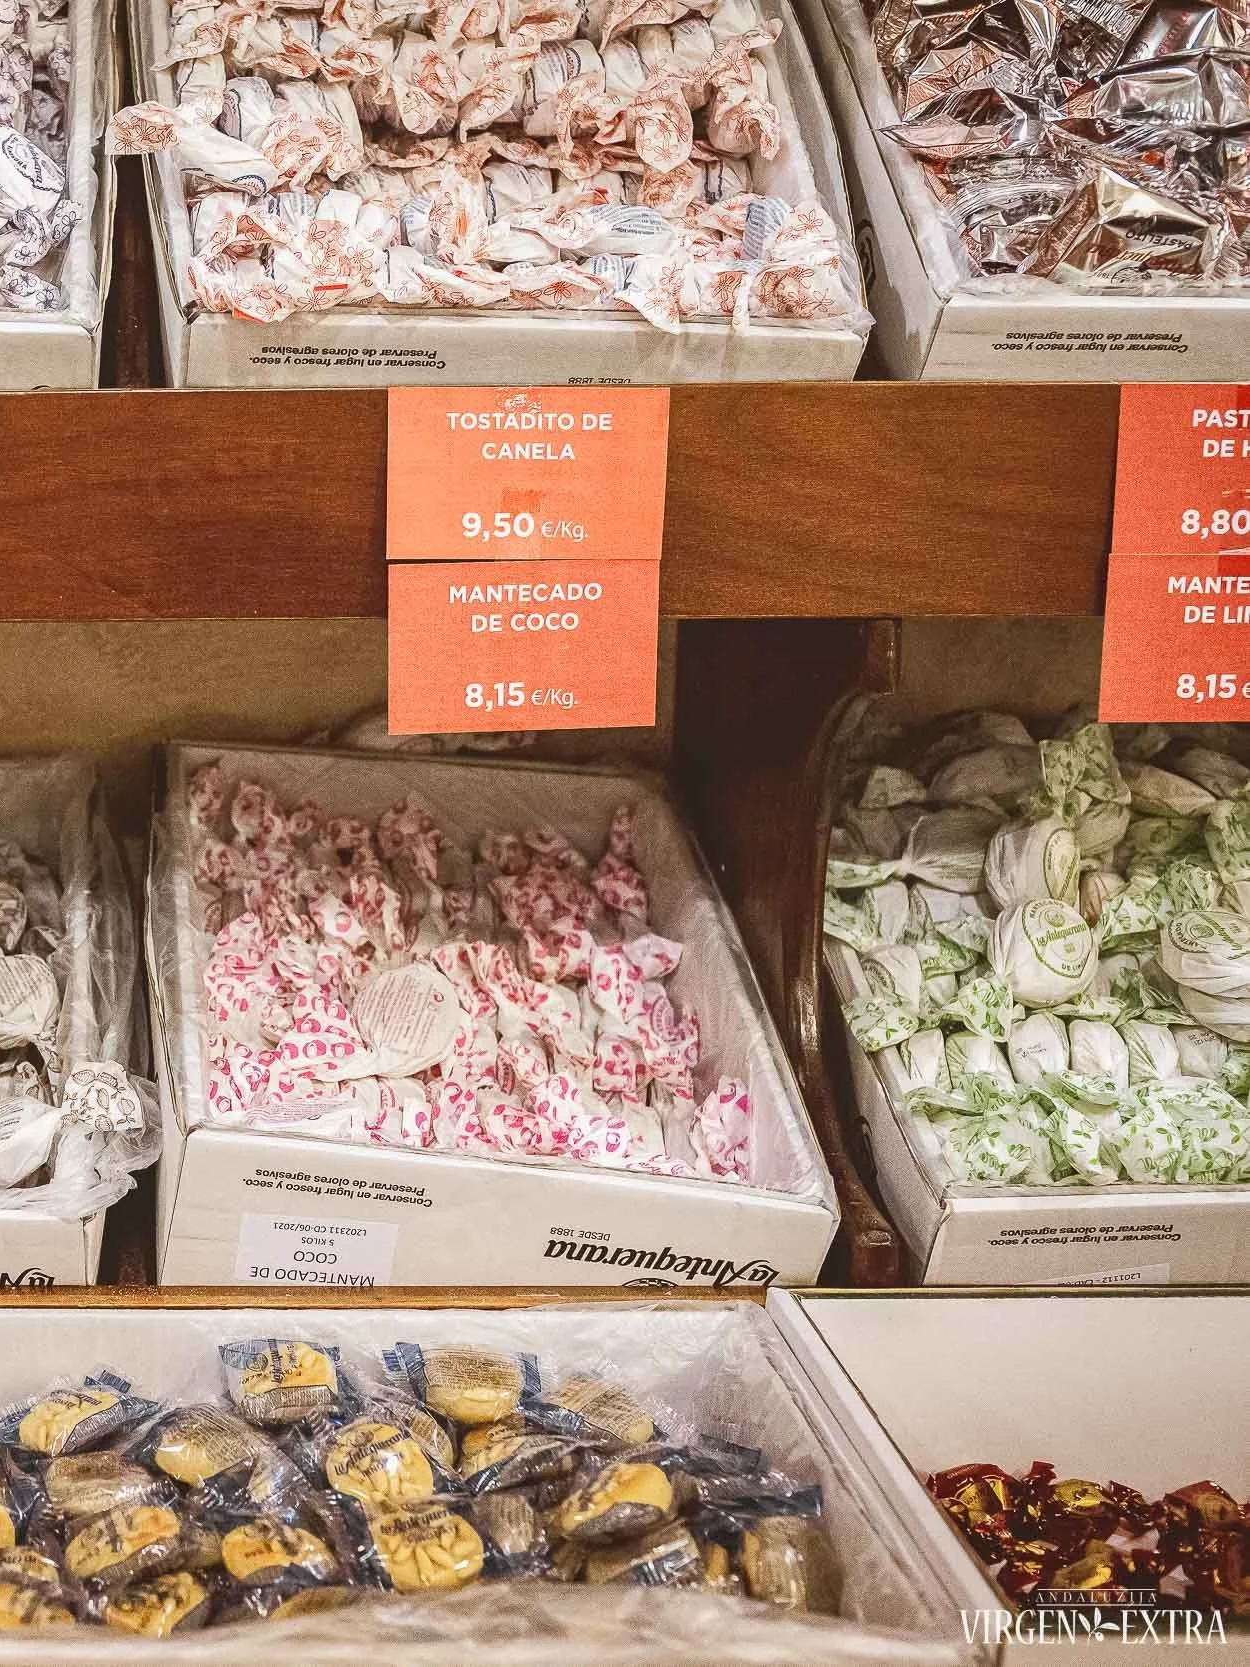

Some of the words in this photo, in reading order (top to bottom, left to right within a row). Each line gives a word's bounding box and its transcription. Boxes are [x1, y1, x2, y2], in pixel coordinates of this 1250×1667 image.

[1125, 231, 1193, 250] PASTELITO
[1006, 332, 1064, 341] agresivos
[1066, 332, 1104, 342] olores
[1107, 333, 1122, 341] de
[1124, 333, 1182, 342] Preservar
[261, 346, 319, 356] agresivos
[991, 343, 1023, 351] seco.
[1036, 344, 1074, 353] fresco
[1075, 343, 1107, 353] lugar
[1126, 344, 1189, 354] Conservar
[321, 348, 359, 357] olores
[362, 348, 377, 357] de
[379, 349, 437, 359] Preservar
[250, 357, 281, 365] seco.
[294, 357, 331, 367] fresco
[334, 357, 364, 367] lugar
[367, 359, 382, 367] en
[384, 359, 446, 370] Conservar
[445, 412, 575, 431] TOSTADITO
[581, 413, 614, 431] DE
[481, 442, 575, 460] CANELA
[1203, 439, 1235, 458] DE
[461, 512, 535, 542] 9,50
[541, 520, 589, 542] €/Kg.
[1181, 509, 1250, 539] 8,80
[1167, 576, 1250, 594] MANTE
[448, 582, 603, 604] MANTECADO
[1184, 605, 1216, 624] DE
[471, 614, 503, 633] DE
[510, 612, 579, 632] COCO
[1176, 673, 1237, 703] 8,15
[464, 682, 525, 712] 8,15
[531, 689, 578, 710] €/Kg.
[255, 1168, 311, 1182] agresivos
[242, 1178, 273, 1188] seco.
[314, 1175, 350, 1186] olores
[352, 1179, 367, 1189] de
[286, 1183, 323, 1196] fresco
[324, 1187, 354, 1199] lugar
[369, 1181, 425, 1197] Preservar
[357, 1190, 372, 1199] en
[373, 1192, 433, 1208] Conservar
[273, 1222, 327, 1233] CD-06/2021
[550, 1227, 574, 1237] 1888
[1000, 1227, 1057, 1237] agresivos
[1059, 1226, 1096, 1234] olores
[1099, 1225, 1113, 1233] de
[1113, 1224, 1173, 1233] Preservar
[301, 1237, 327, 1246] KILOS
[578, 1231, 611, 1242] DESDE
[1031, 1235, 1068, 1245] fresco
[1070, 1234, 1100, 1244] lugar
[1103, 1234, 1118, 1242] en
[1121, 1232, 1182, 1242] Conservar
[988, 1238, 1019, 1247] seco.
[293, 1250, 338, 1264] COCO
[543, 1239, 768, 1288] Antequerana
[250, 1266, 270, 1279] DE
[274, 1268, 375, 1288] MANTECADO
